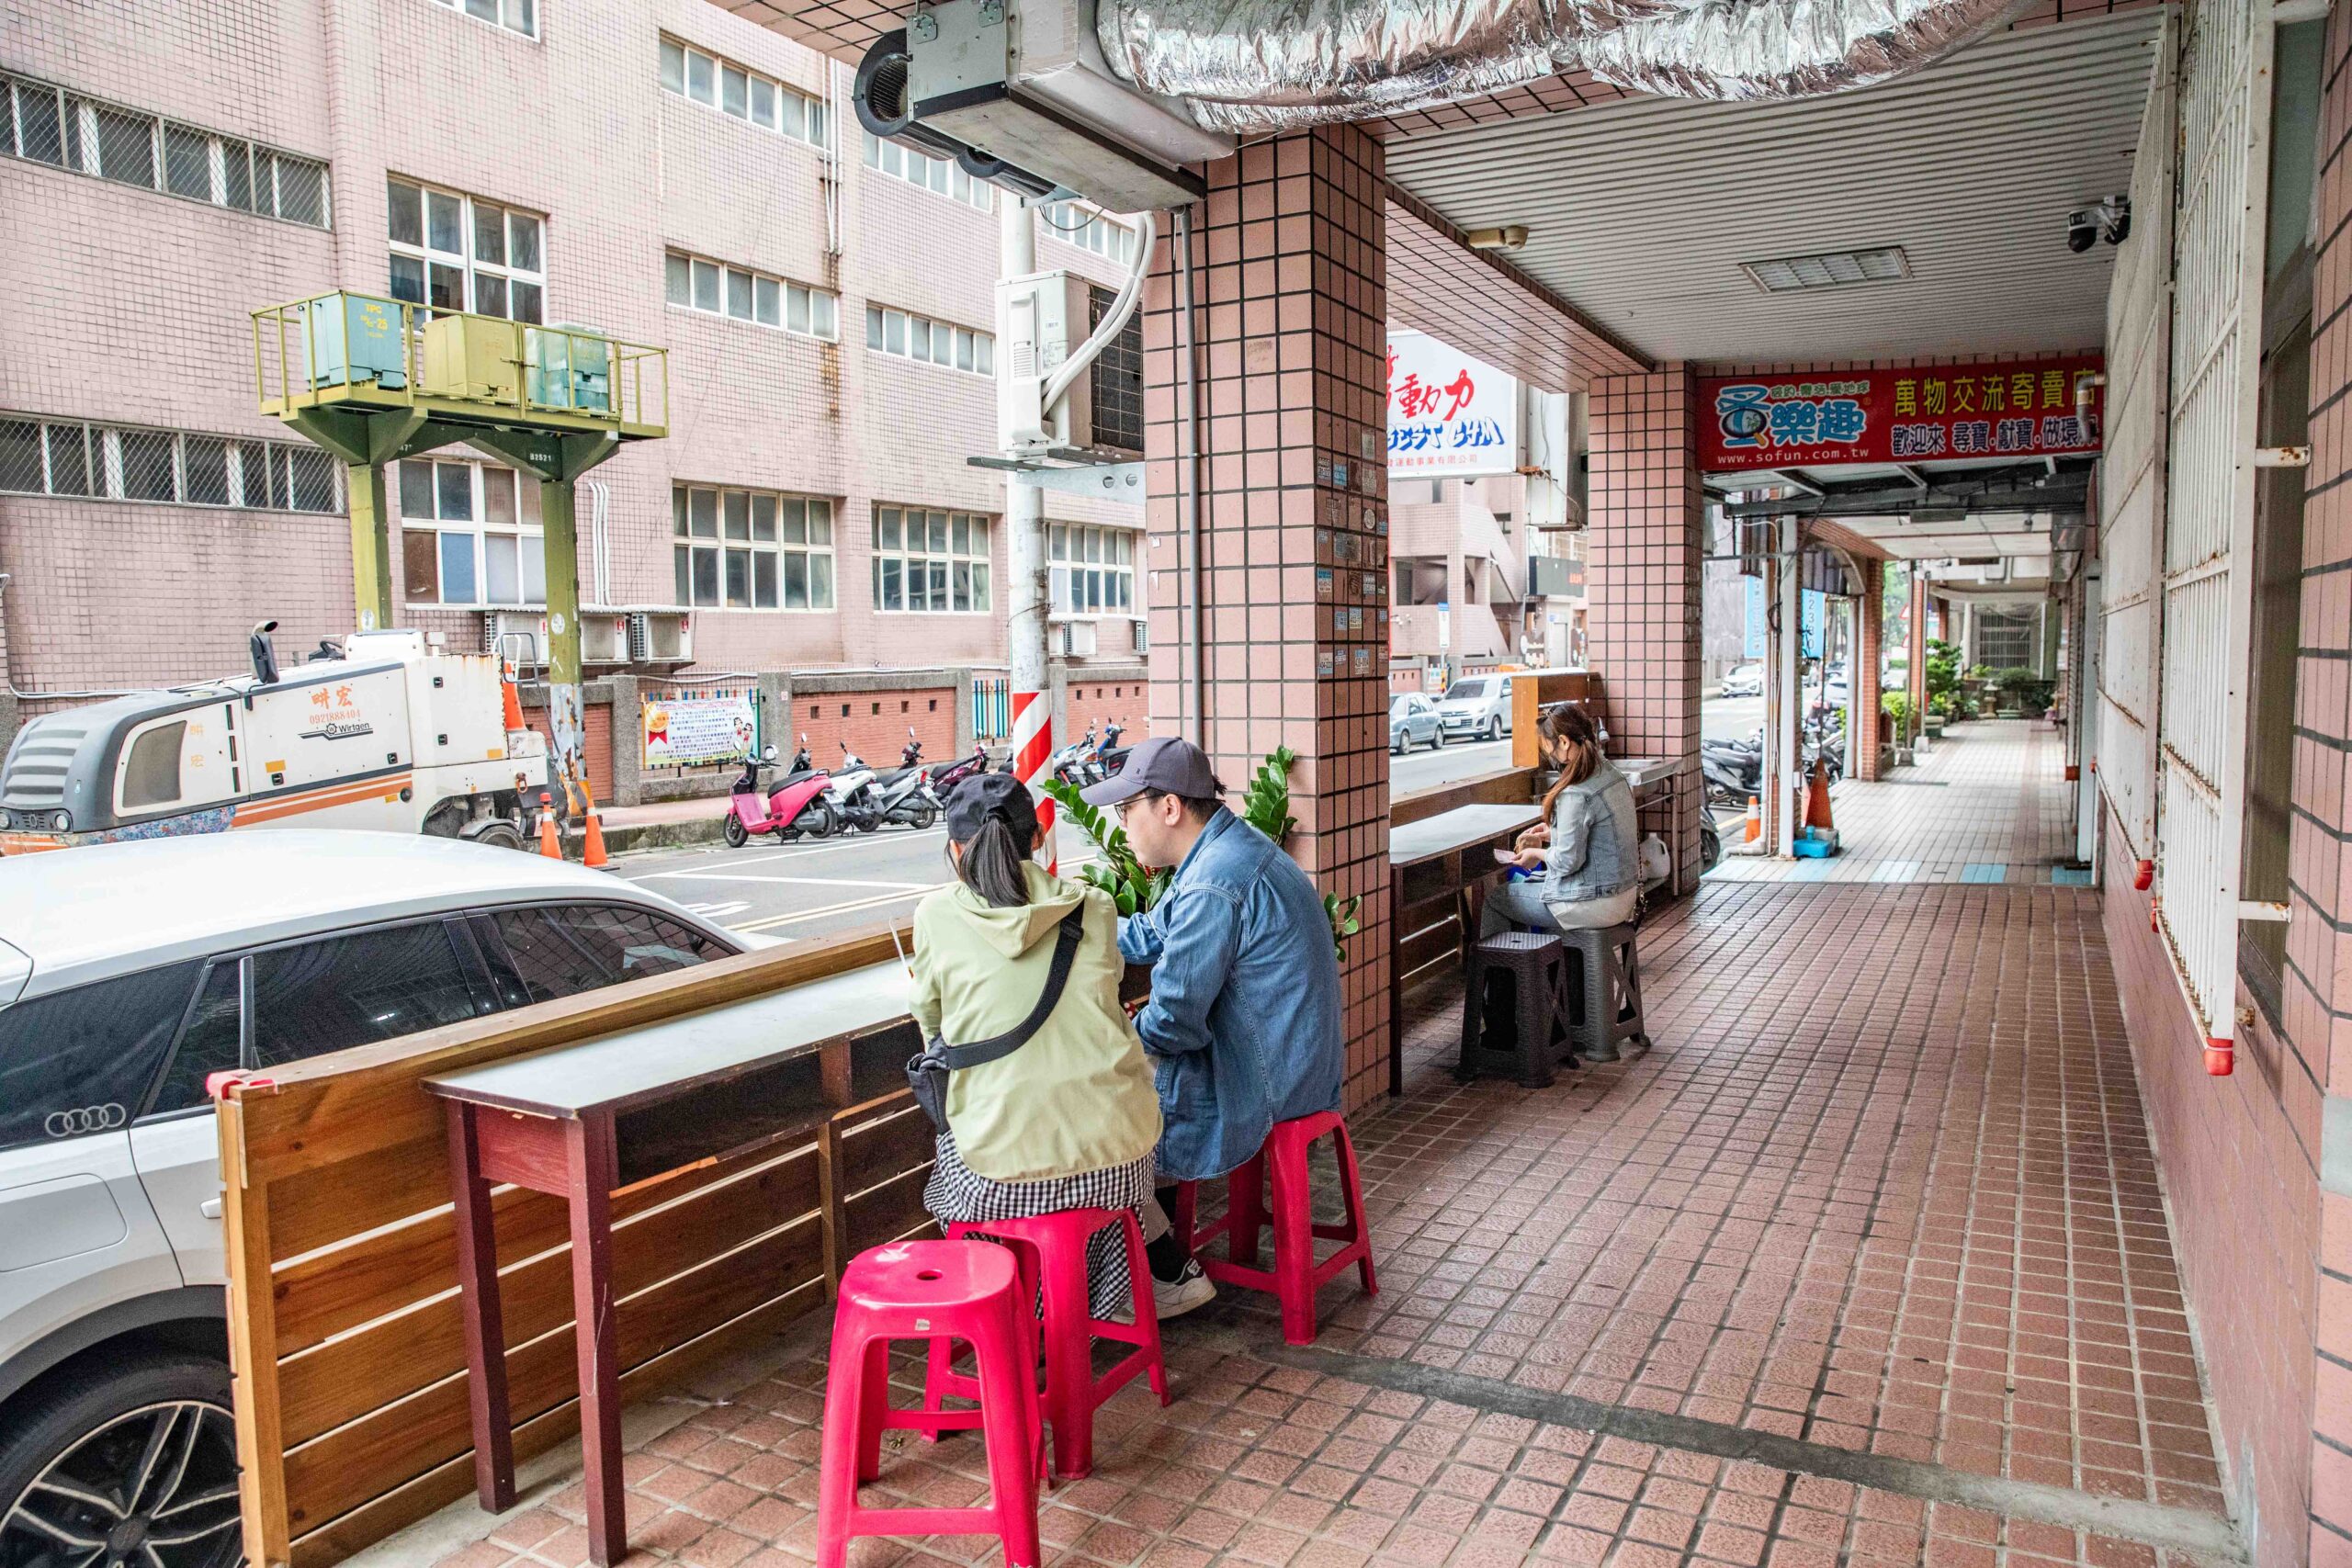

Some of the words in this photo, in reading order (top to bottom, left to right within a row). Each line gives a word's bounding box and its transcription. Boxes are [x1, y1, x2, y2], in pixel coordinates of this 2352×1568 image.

[1387, 368, 1475, 422] 動力
[1892, 423, 1946, 457] 歡迎來
[1717, 448, 1869, 464] www.sofun.com.tw
[339, 723, 369, 733] Wirtgen
